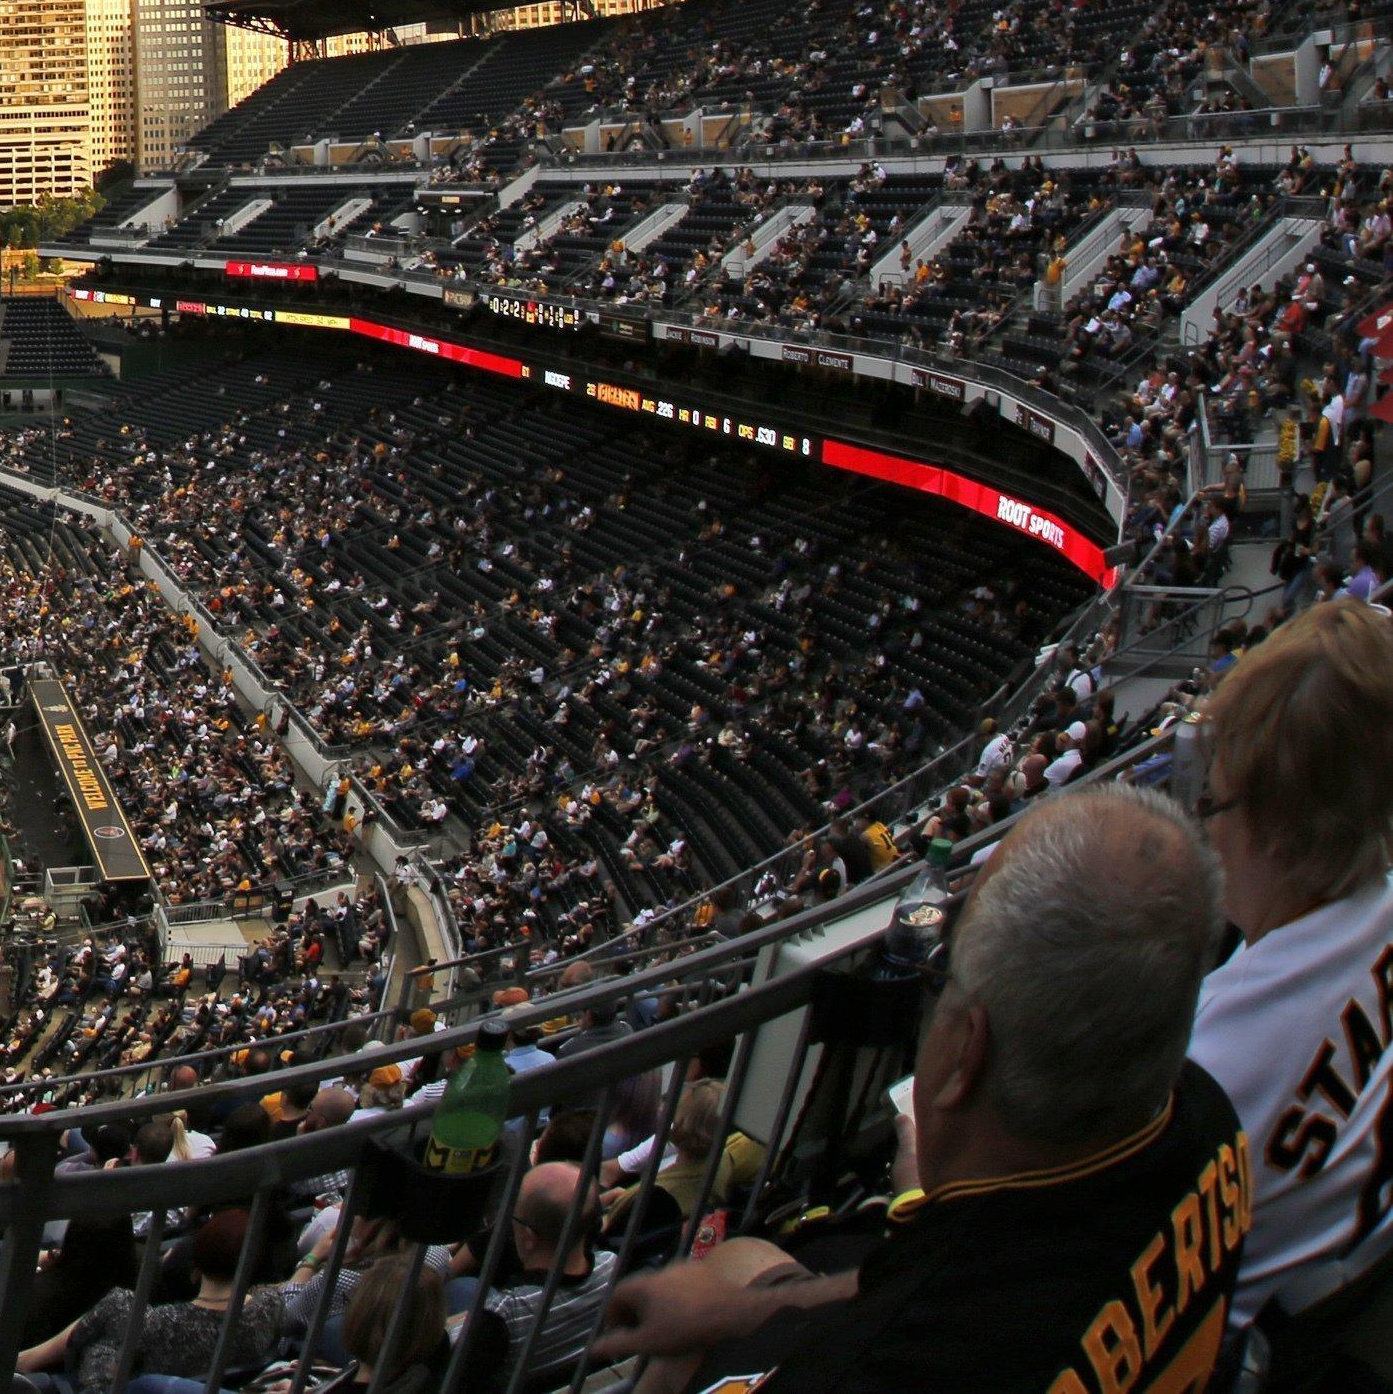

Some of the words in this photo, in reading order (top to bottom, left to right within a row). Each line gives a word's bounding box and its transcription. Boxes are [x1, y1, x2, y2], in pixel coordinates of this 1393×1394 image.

[691, 332, 716, 346] ROBINSON
[783, 348, 808, 362] ROBERTO
[818, 354, 849, 369] CLEMENTE
[912, 372, 923, 386] BILL
[930, 379, 960, 396] MAZEROSKI
[642, 399, 655, 413] AVG
[656, 401, 673, 418] .226
[678, 408, 689, 422] HR
[693, 410, 699, 425] 0
[705, 415, 717, 430] RBI
[723, 418, 730, 433] 6
[738, 424, 754, 439] OPS
[755, 426, 776, 446] .630
[783, 435, 795, 450] BB
[802, 438, 810, 455] 8
[997, 495, 1032, 530] ROOT
[1029, 513, 1065, 549] SPORTS
[54, 724, 79, 743] PARK
[63, 743, 86, 760] PNC
[71, 759, 88, 769] TO
[73, 769, 108, 810] WELCOME
